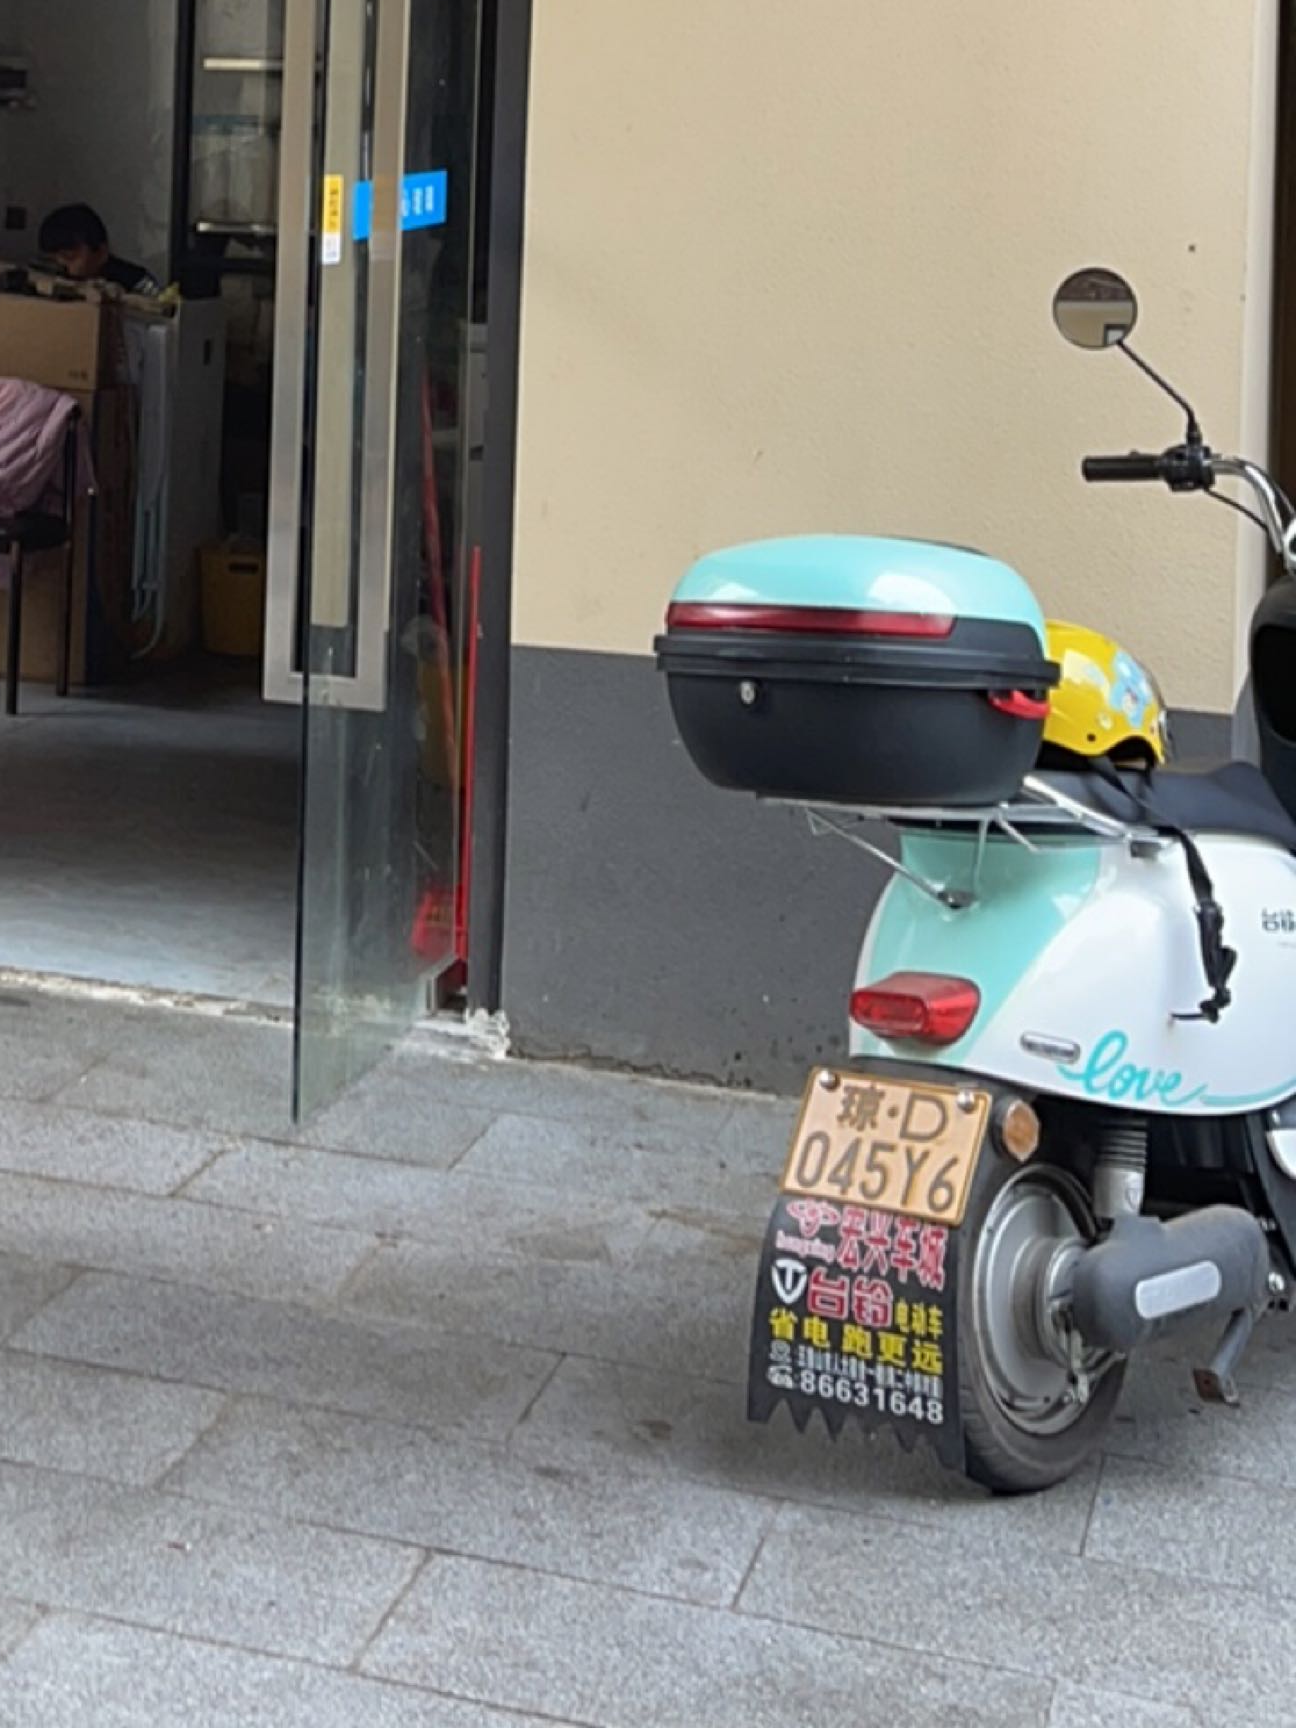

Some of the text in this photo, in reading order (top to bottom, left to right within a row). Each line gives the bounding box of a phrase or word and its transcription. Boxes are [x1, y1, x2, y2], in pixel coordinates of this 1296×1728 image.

[1056, 1029, 1207, 1107] love
[793, 1130, 960, 1214] 045Y6
[799, 1368, 944, 1425] 86631648
